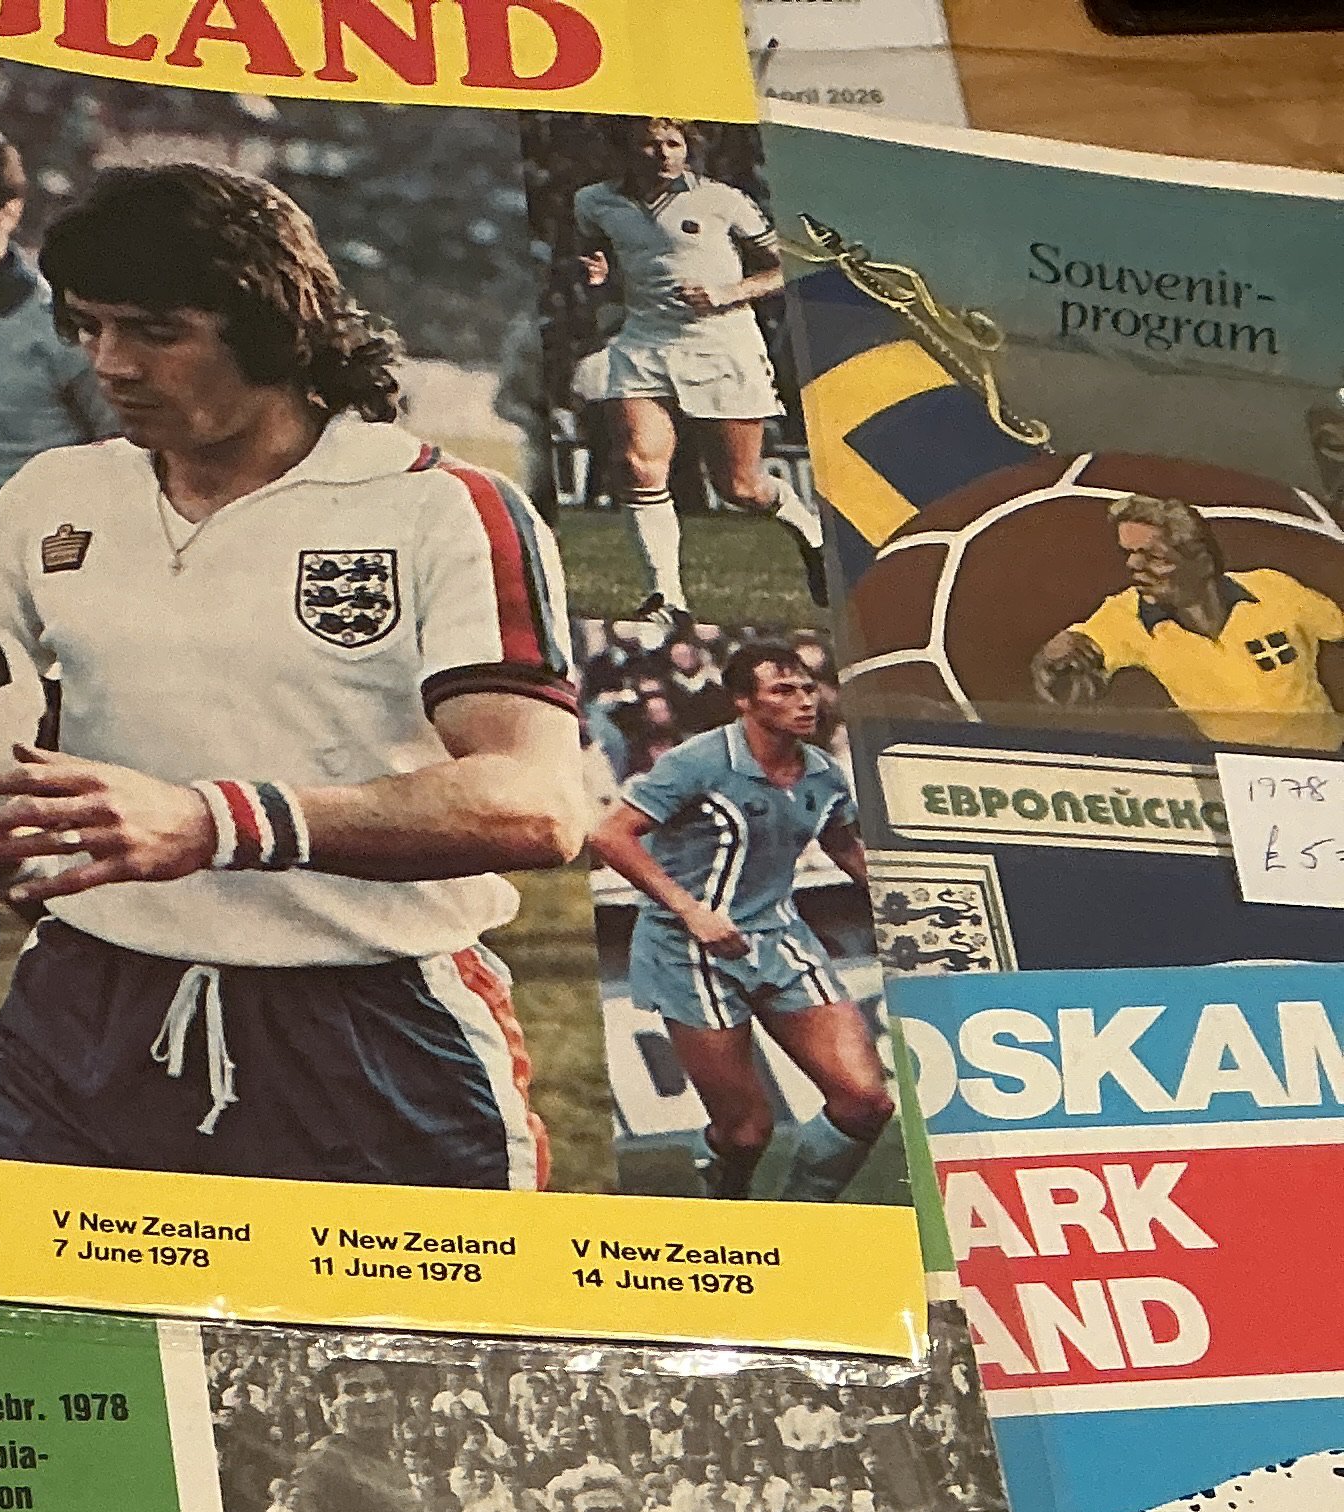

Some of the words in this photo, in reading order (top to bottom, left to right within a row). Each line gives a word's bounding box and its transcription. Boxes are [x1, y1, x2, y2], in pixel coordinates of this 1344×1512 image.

[1029, 243, 1276, 308] Souvenir-
[1062, 300, 1278, 355] program
[1250, 775, 1329, 802] 1978
[52, 1210, 70, 1229] V
[79, 1213, 137, 1235] New
[141, 1217, 251, 1242] Zealand
[52, 1239, 69, 1257] 7
[78, 1241, 142, 1264] June
[148, 1246, 210, 1268] 1978
[311, 1227, 329, 1246] V
[339, 1230, 398, 1252] New
[403, 1232, 517, 1256] Zealand
[571, 1239, 590, 1258] V
[600, 1240, 660, 1262] New
[665, 1243, 781, 1266] Zealand
[309, 1256, 334, 1276] 11
[344, 1257, 412, 1280] June
[417, 1262, 482, 1283] 1978
[572, 1268, 604, 1287] 14
[616, 1269, 684, 1291] June
[688, 1274, 754, 1295] 1978
[59, 1392, 129, 1422] 1978
